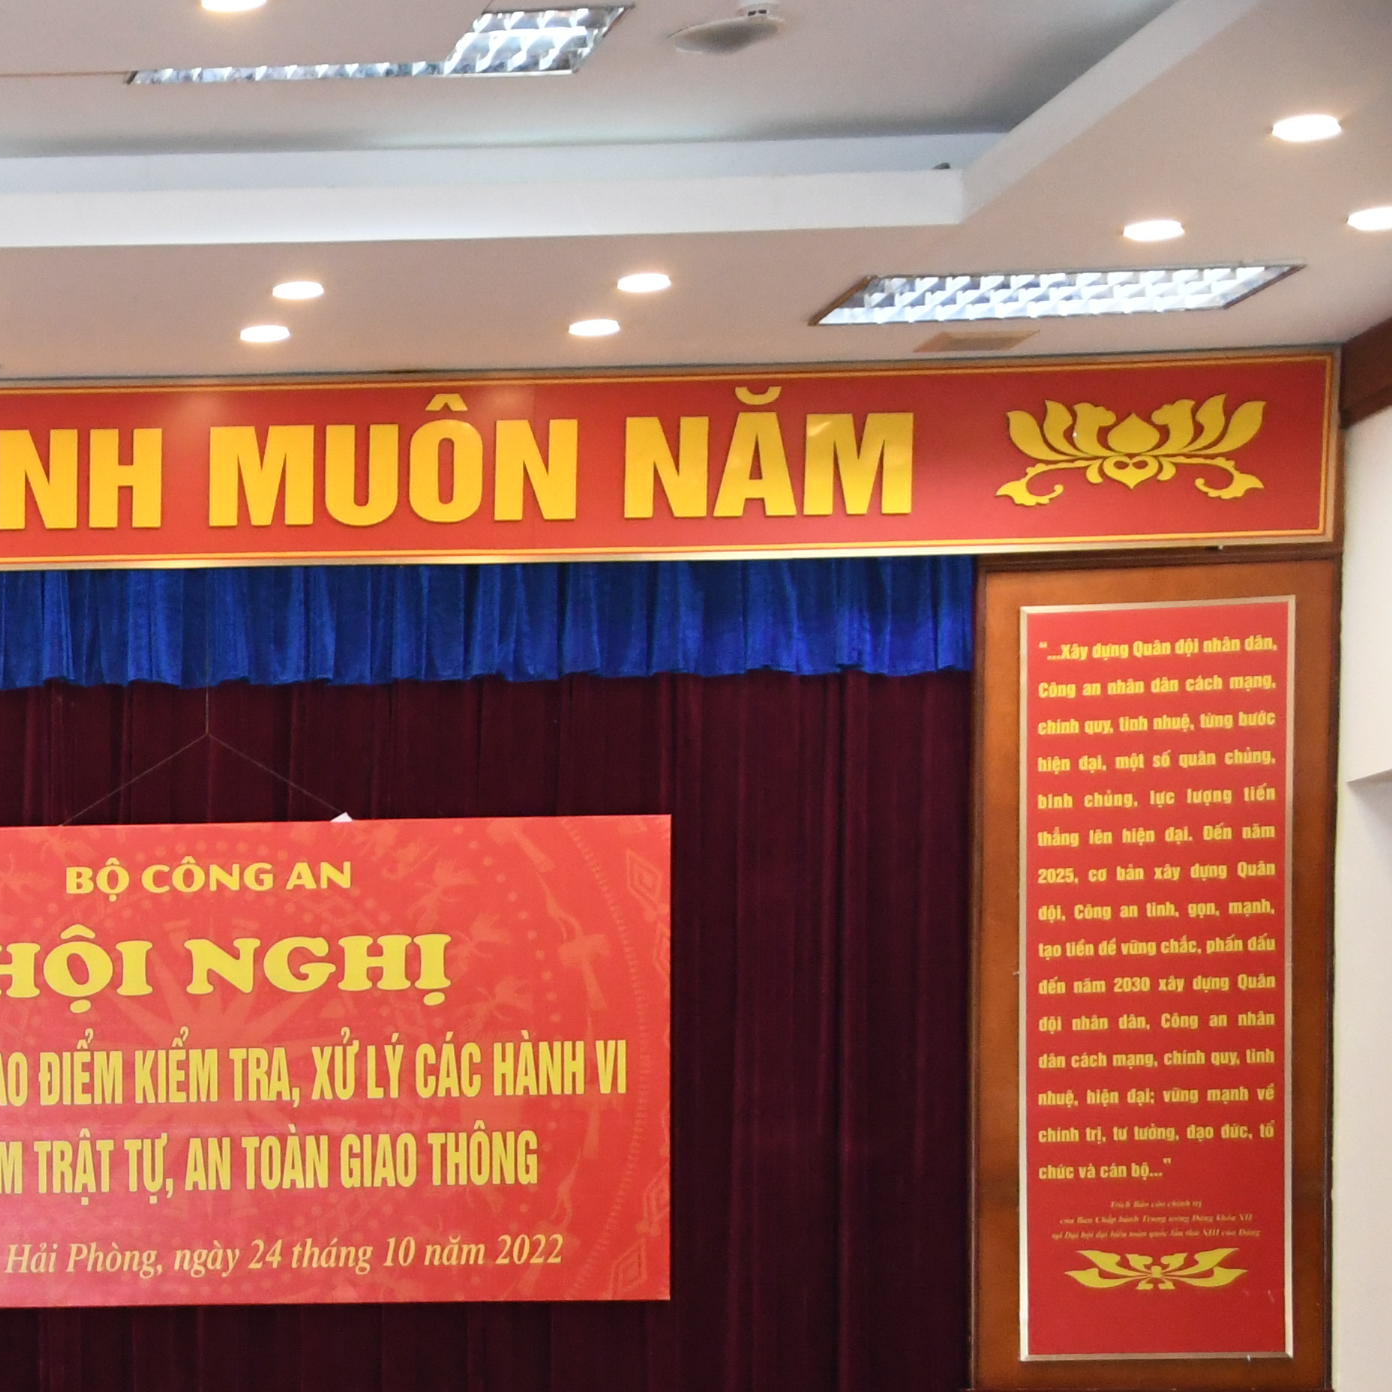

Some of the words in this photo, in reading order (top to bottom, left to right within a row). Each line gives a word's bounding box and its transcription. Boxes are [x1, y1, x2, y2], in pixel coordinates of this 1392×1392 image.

[209, 393, 578, 526] MUÔN
[624, 387, 913, 518] NĂM
[65, 856, 130, 902] BỘ
[141, 855, 274, 894] CÔNG
[285, 860, 352, 890] AN
[183, 933, 452, 1007] NGHỊ
[38, 1028, 124, 1106] ĐIỂM
[134, 1026, 218, 1104] KIỂM
[229, 1046, 300, 1108] TRA,
[312, 1026, 360, 1100] XỬ
[366, 1033, 404, 1099] LÝ
[415, 1031, 482, 1098] CÁC
[493, 1029, 585, 1097] HÀNH
[595, 1039, 627, 1094] VI
[33, 1128, 114, 1206] TRẬT
[124, 1133, 174, 1205] TỰ,
[184, 1136, 231, 1193] AN
[245, 1124, 330, 1191] TOÀN
[340, 1133, 417, 1190] GIAO
[427, 1120, 539, 1187] THÔNG
[6, 1241, 58, 1275] Hải
[66, 1241, 164, 1279] Phòng,
[173, 1241, 241, 1279] ngày
[249, 1241, 284, 1270] 24
[291, 1238, 375, 1275] tháng
[386, 1236, 416, 1268] 10
[424, 1238, 487, 1267] năm
[495, 1234, 564, 1266] 2022
